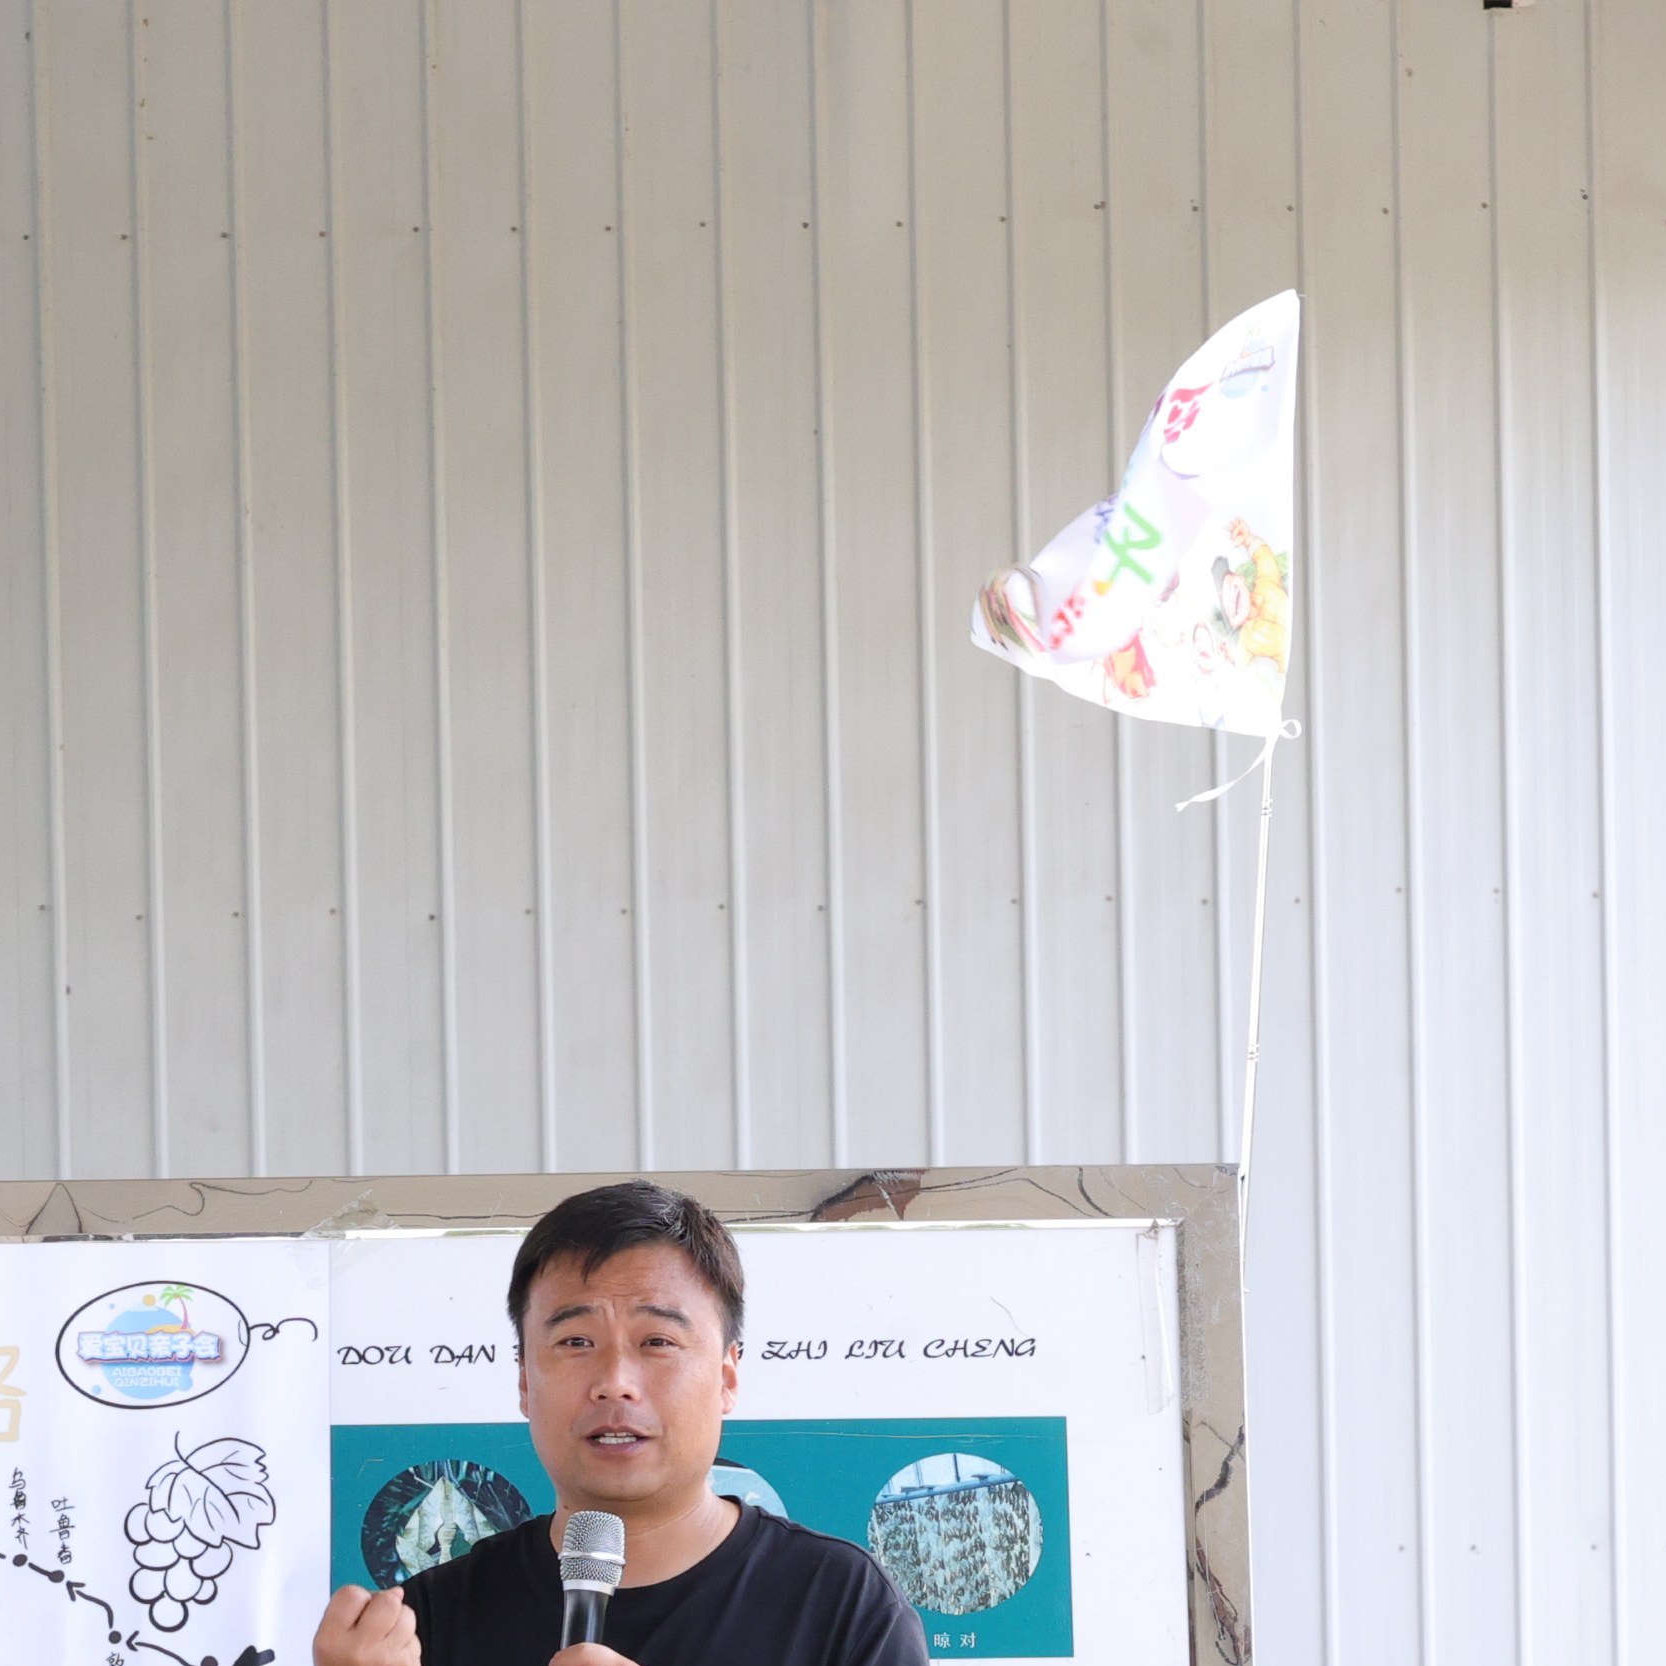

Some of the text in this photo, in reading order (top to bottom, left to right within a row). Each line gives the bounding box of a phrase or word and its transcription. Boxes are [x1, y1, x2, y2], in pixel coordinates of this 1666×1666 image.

[78, 1332, 220, 1361] 爱宝贝亲子会
[336, 1345, 413, 1366] DOU
[429, 1344, 496, 1365] DAN
[760, 1339, 828, 1361] ZHI
[844, 1339, 906, 1360] LIU
[922, 1337, 1037, 1359] CHENG
[112, 1366, 181, 1377] AIBAOBEI
[114, 1378, 179, 1387] QINZIHUI
[8, 1466, 30, 1551] 乌鲁木齐
[933, 1631, 977, 1649] 晾对
